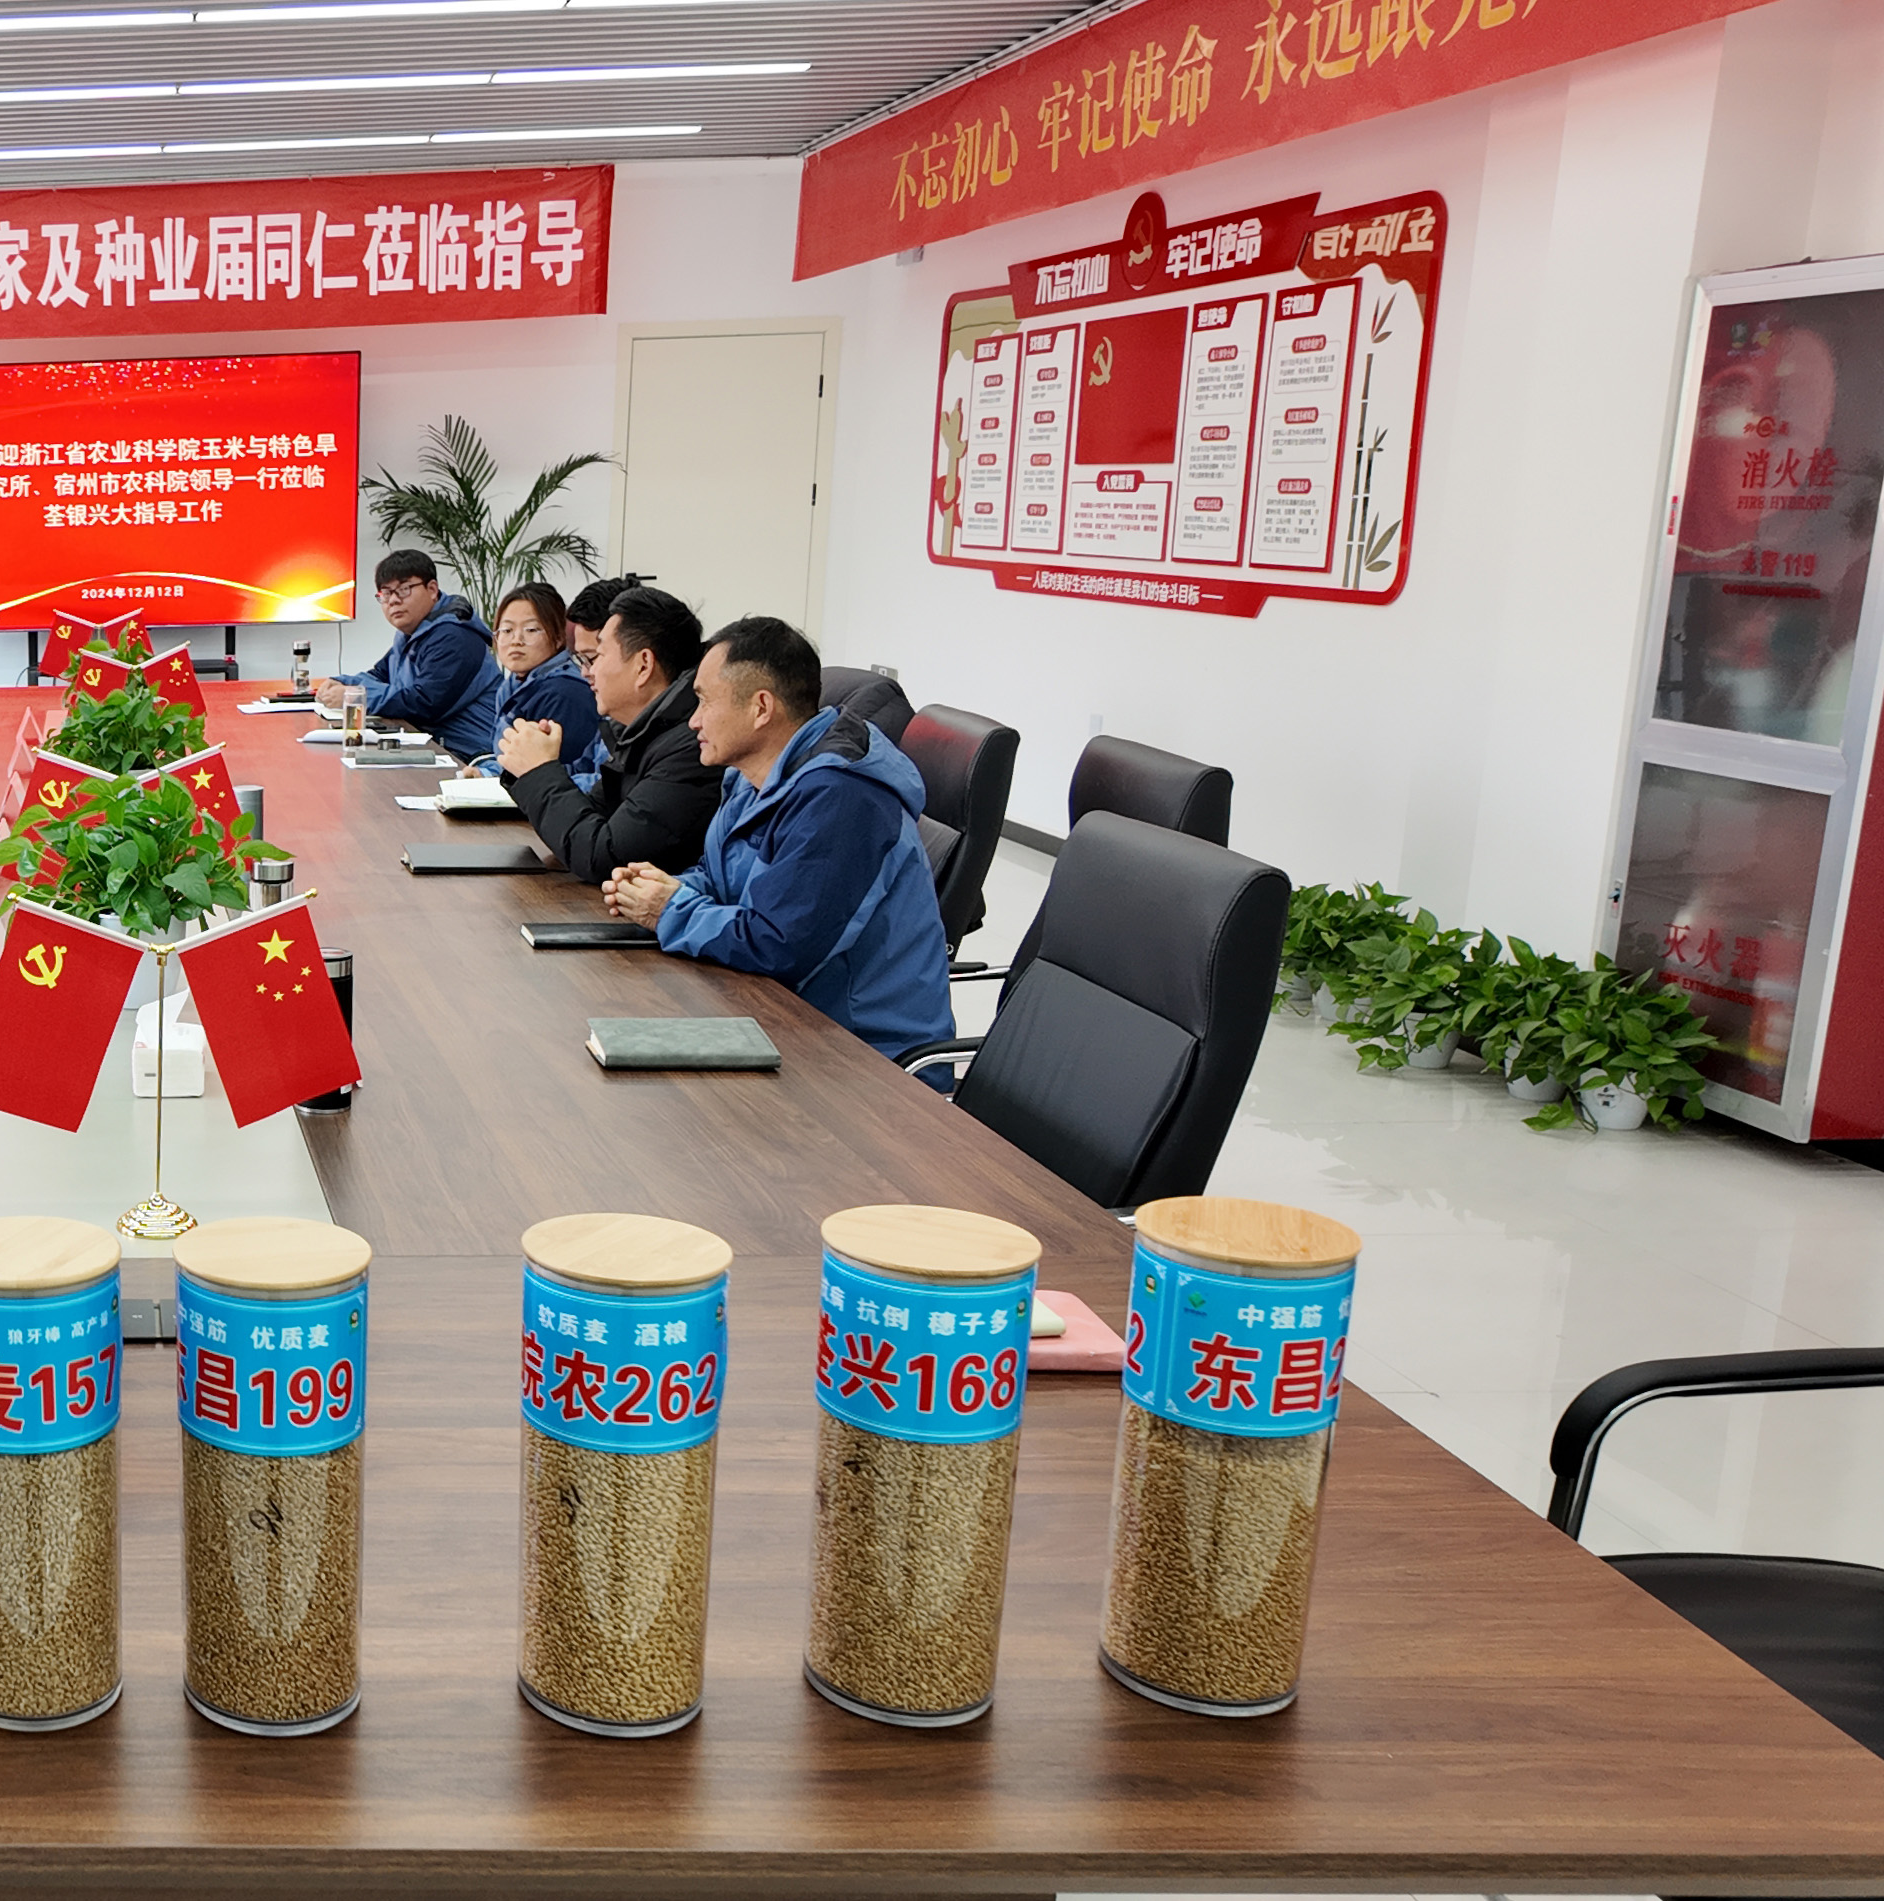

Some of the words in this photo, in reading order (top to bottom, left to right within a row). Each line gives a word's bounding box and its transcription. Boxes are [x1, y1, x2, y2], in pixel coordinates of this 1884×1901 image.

[889, 105, 1018, 222] 不忘初心
[1037, 24, 1218, 173] 牢记使命
[1035, 254, 1110, 305] 不忘初心
[1165, 218, 1263, 279] 牢记使命
[1741, 447, 1838, 489] 消火栓
[44, 500, 223, 527] 荃银兴大指导工作
[1783, 553, 1816, 577] 119
[81, 584, 185, 600] 2024年12月12日
[1661, 923, 1760, 982] 灭火器
[8, 1326, 61, 1345] 狼牙棒
[70, 1310, 109, 1338] 高产量
[538, 1303, 609, 1345] 软质麦
[634, 1320, 688, 1347] 酒粮
[857, 1297, 910, 1331] 抗倒
[928, 1309, 1009, 1336] 穗子多
[1237, 1304, 1323, 1330] 中强筋
[250, 1323, 330, 1351] 优质麦
